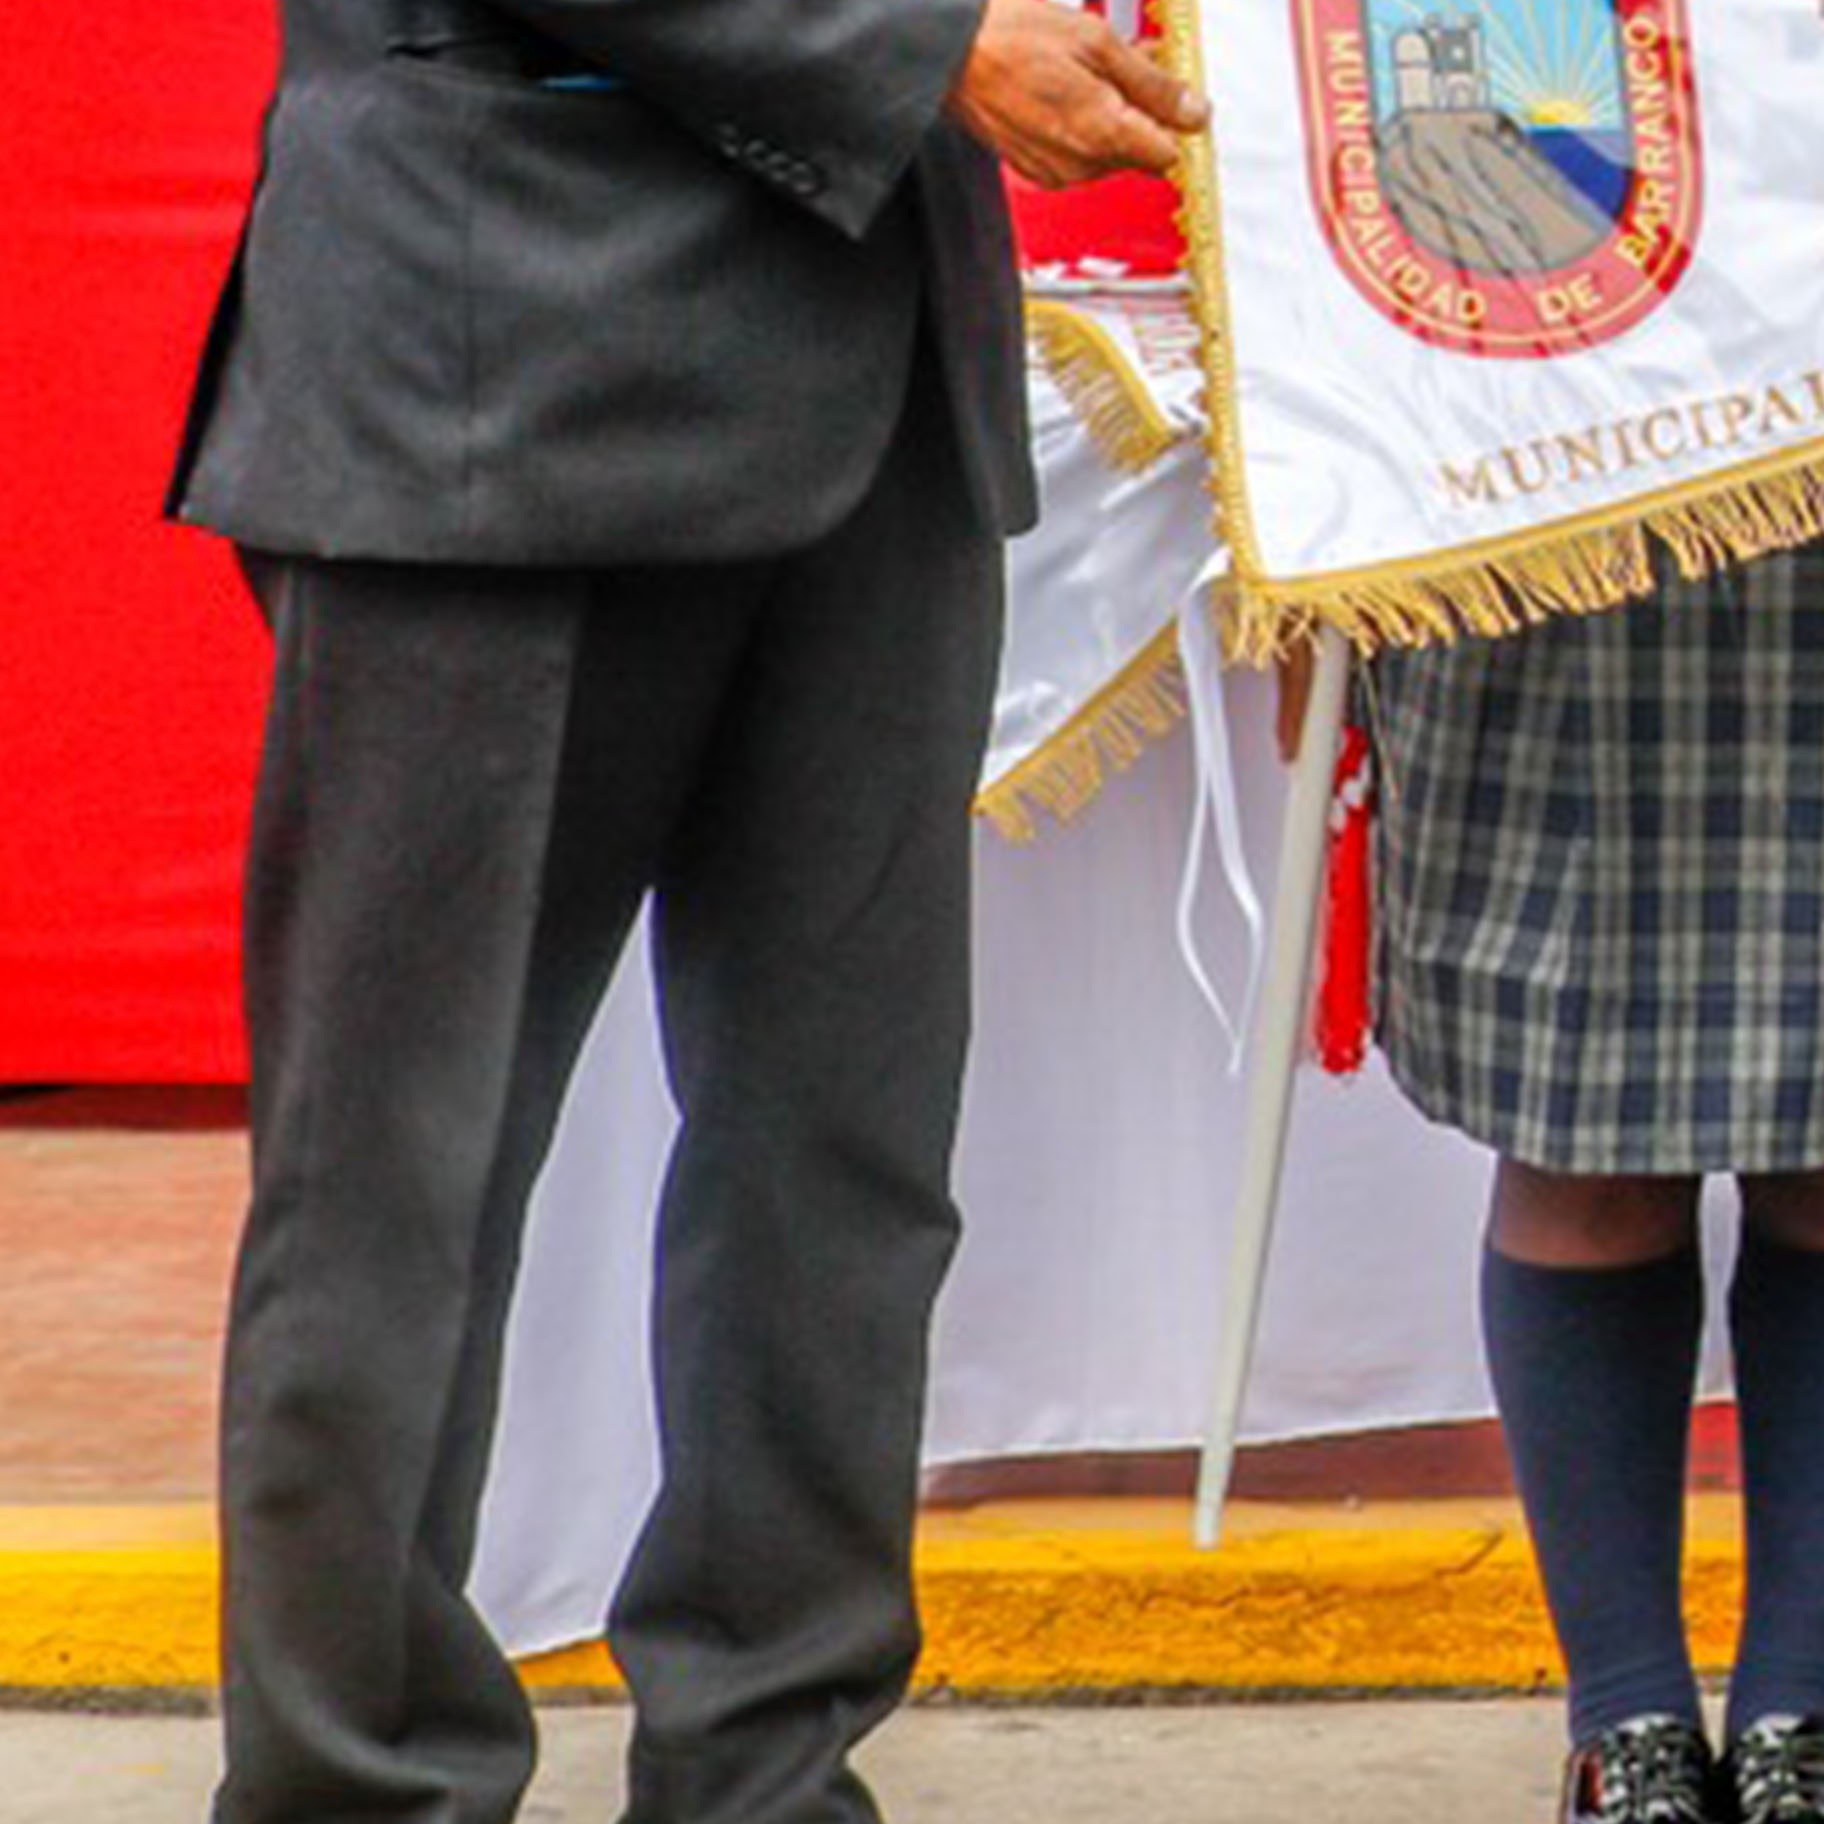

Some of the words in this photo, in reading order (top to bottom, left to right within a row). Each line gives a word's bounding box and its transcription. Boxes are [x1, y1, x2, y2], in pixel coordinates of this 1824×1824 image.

[1325, 31, 1488, 324] MUNICIPALIDAD
[1536, 272, 1602, 323] DE
[1613, 13, 1672, 268] BARRANCO
